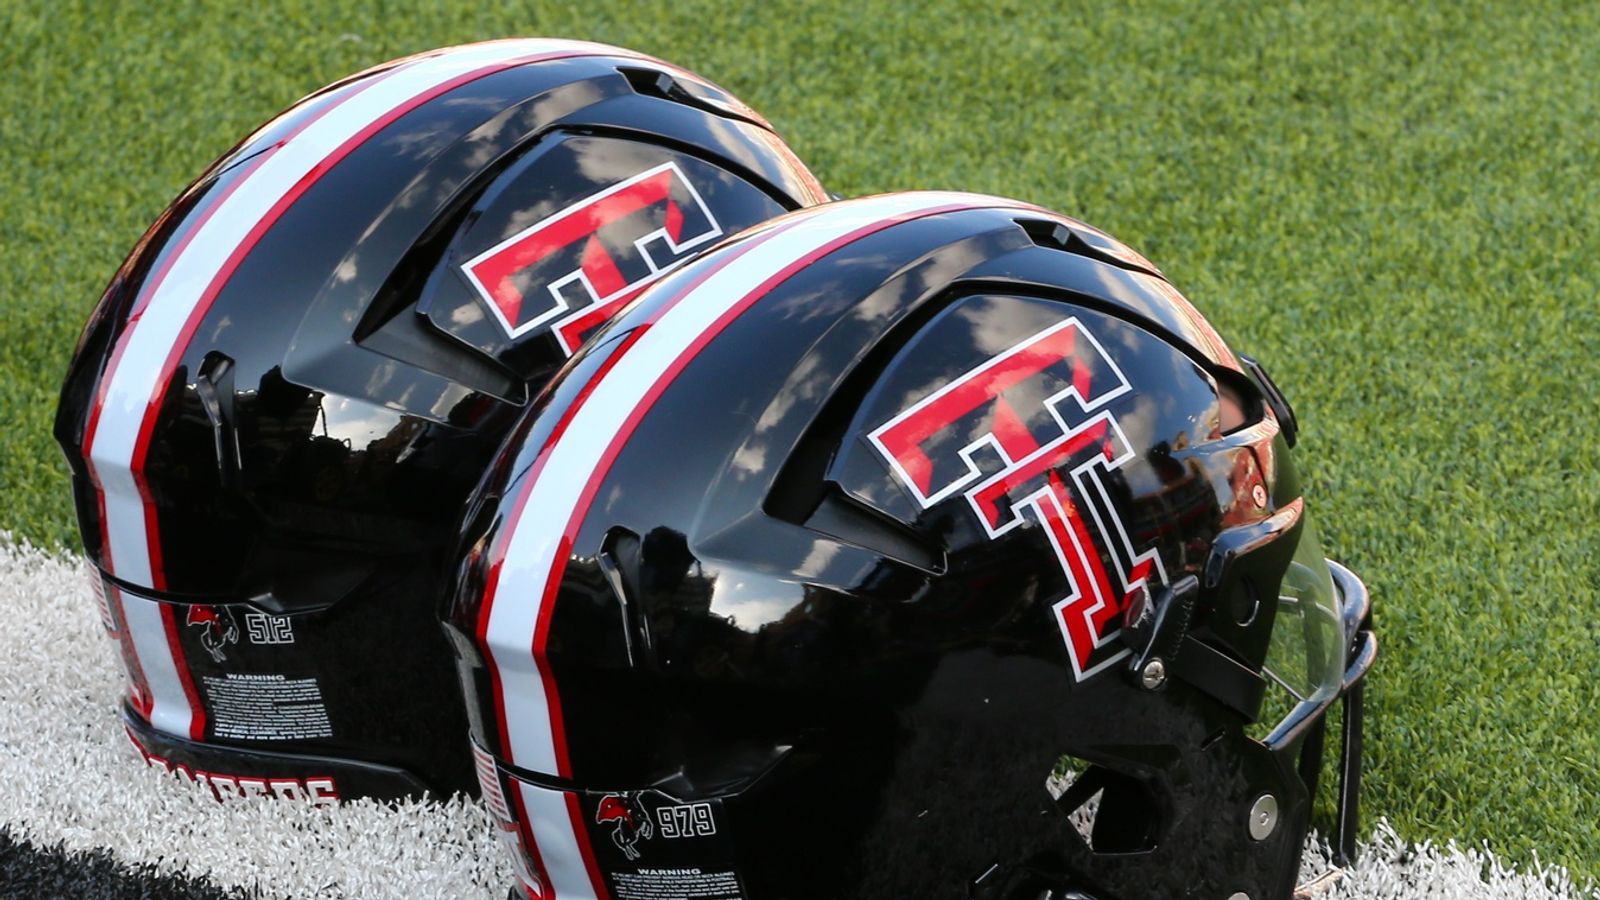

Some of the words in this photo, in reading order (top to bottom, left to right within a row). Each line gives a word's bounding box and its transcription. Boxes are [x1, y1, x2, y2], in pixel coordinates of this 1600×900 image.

[245, 613, 295, 644] 512
[226, 673, 286, 681] WARNING
[656, 803, 717, 838] 979
